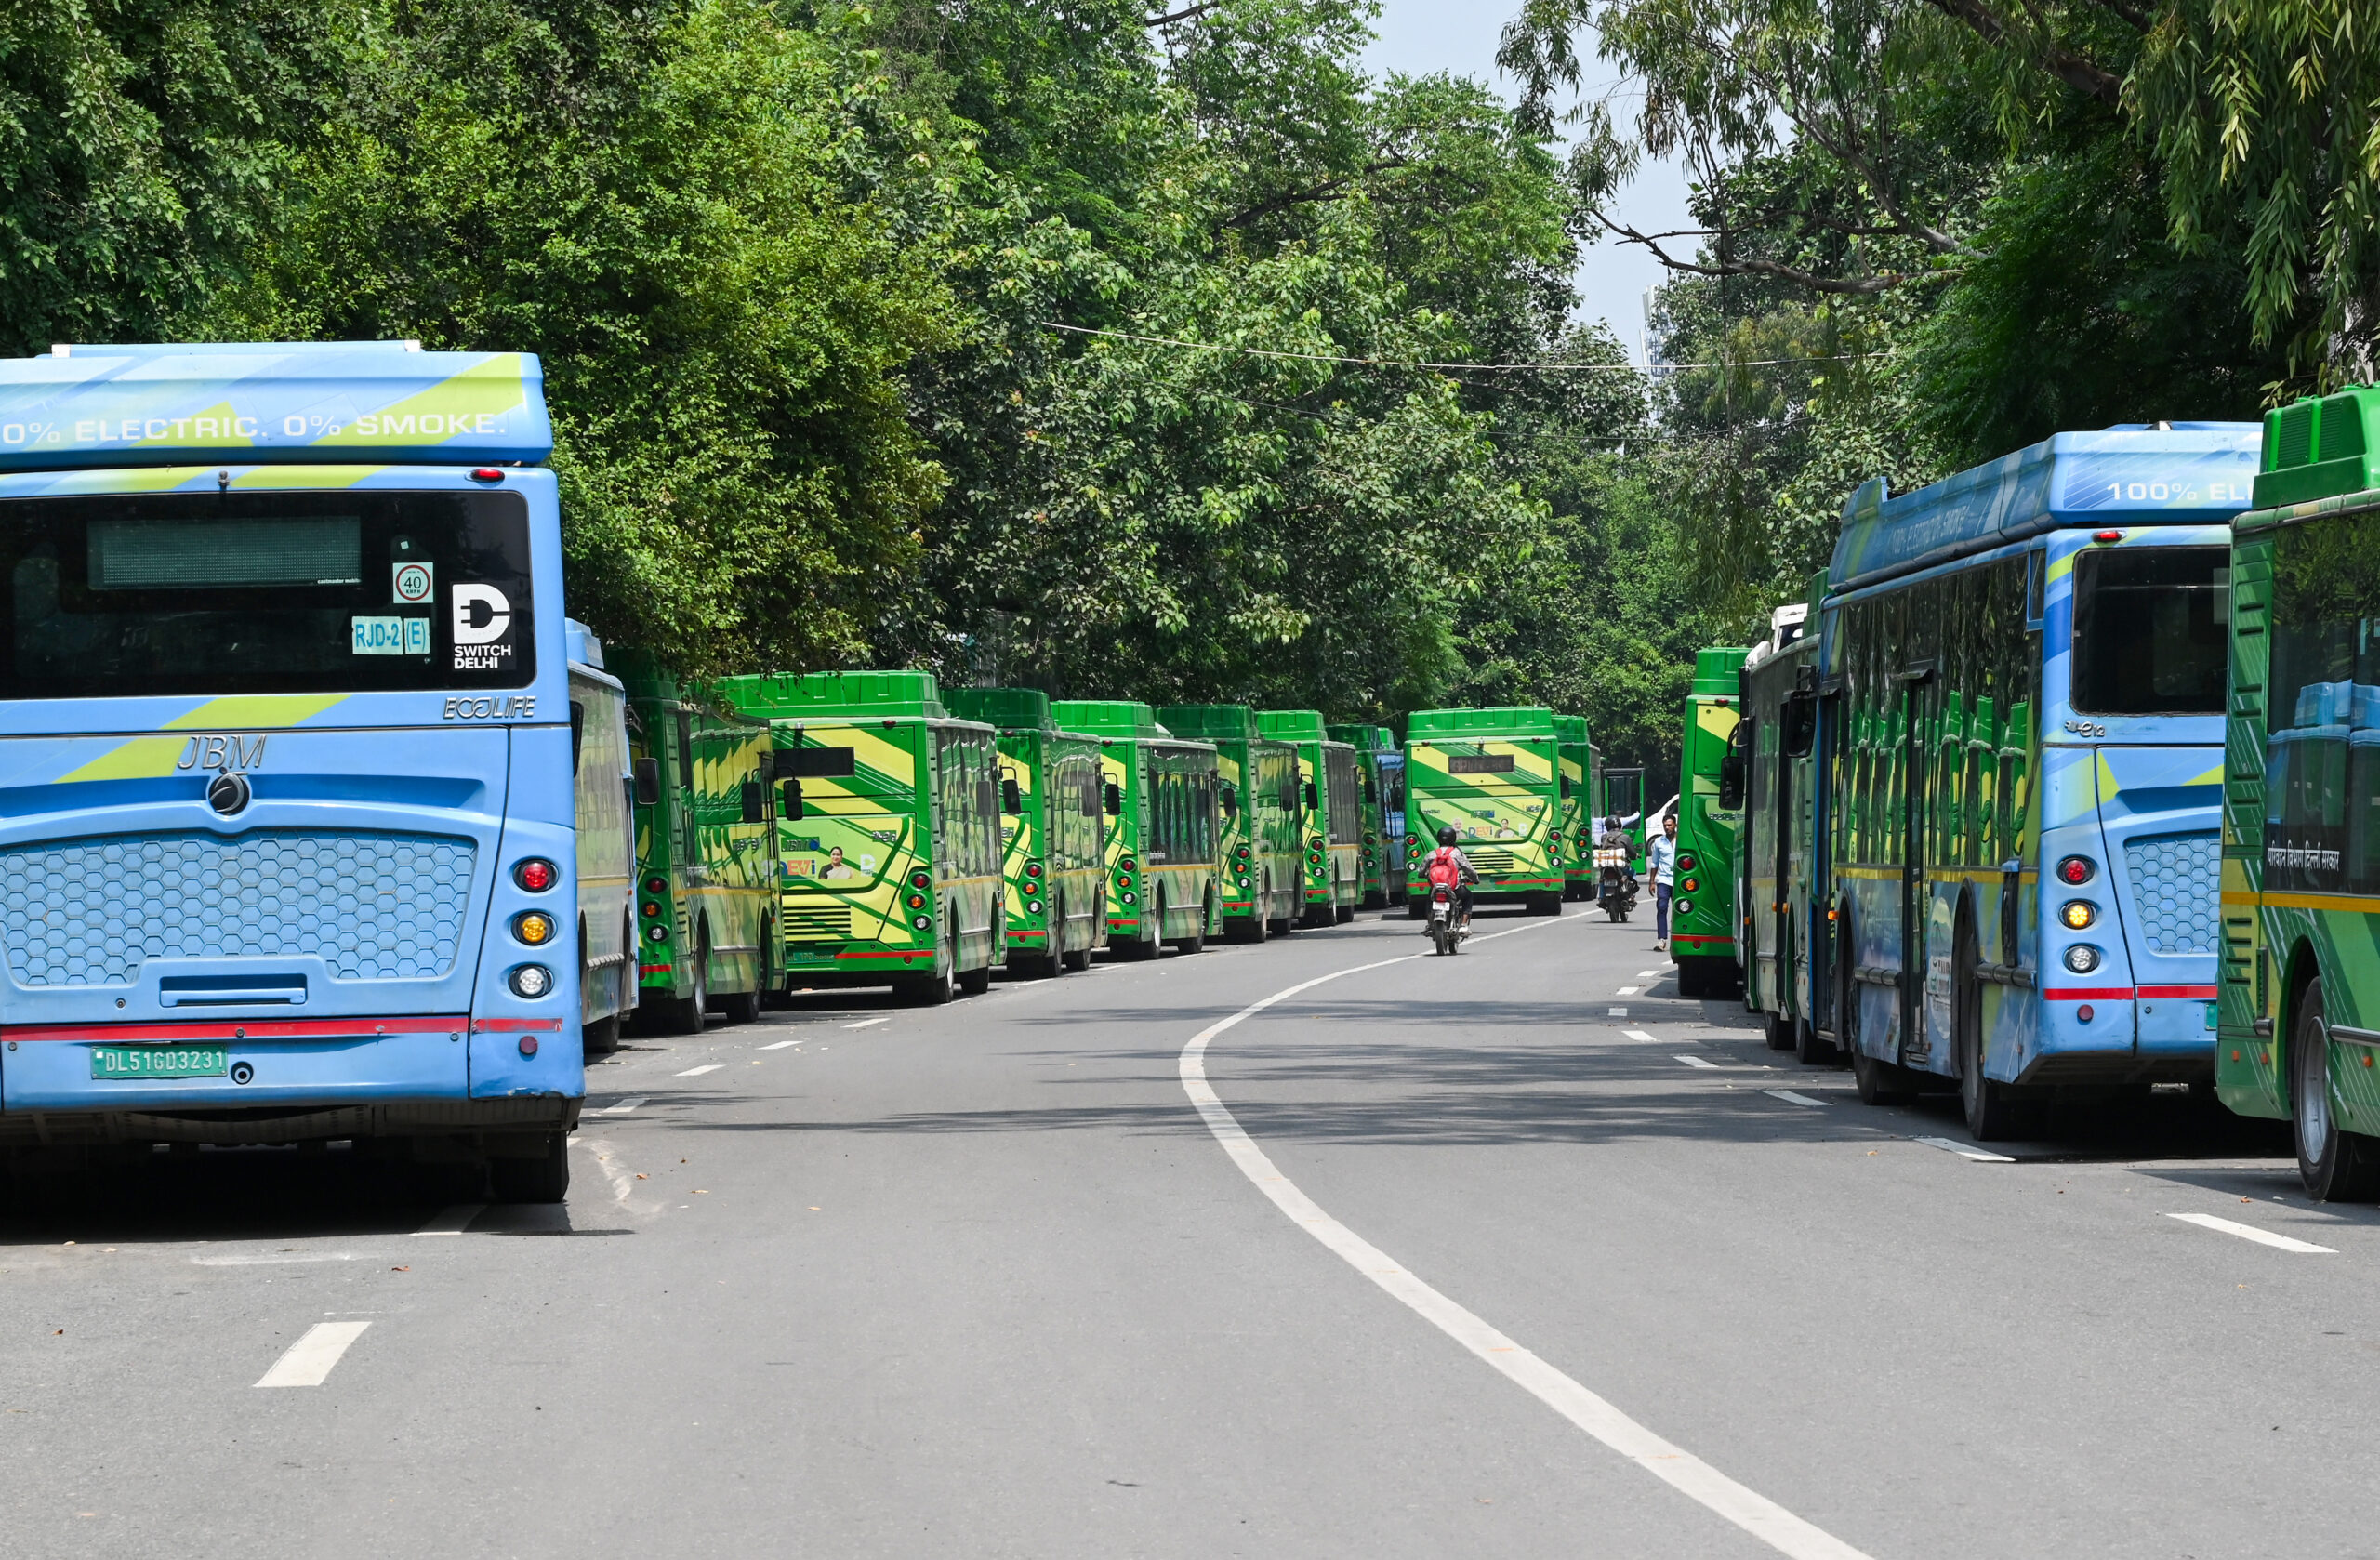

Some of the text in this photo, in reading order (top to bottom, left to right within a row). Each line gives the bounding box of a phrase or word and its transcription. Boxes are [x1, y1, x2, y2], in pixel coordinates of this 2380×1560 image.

[75, 416, 269, 442] ELECTRIC.
[284, 416, 341, 437] 0%
[356, 414, 506, 436] SMOKE.
[2107, 483, 2199, 501] 100%
[403, 576, 422, 589] 40
[355, 621, 427, 652] RJD-2 (E)
[454, 644, 512, 657] SWITCH
[454, 656, 499, 669] DELHI
[443, 695, 537, 720] ECOLIFE
[177, 734, 268, 770] JBM
[105, 1051, 224, 1072] DL51GD3231
